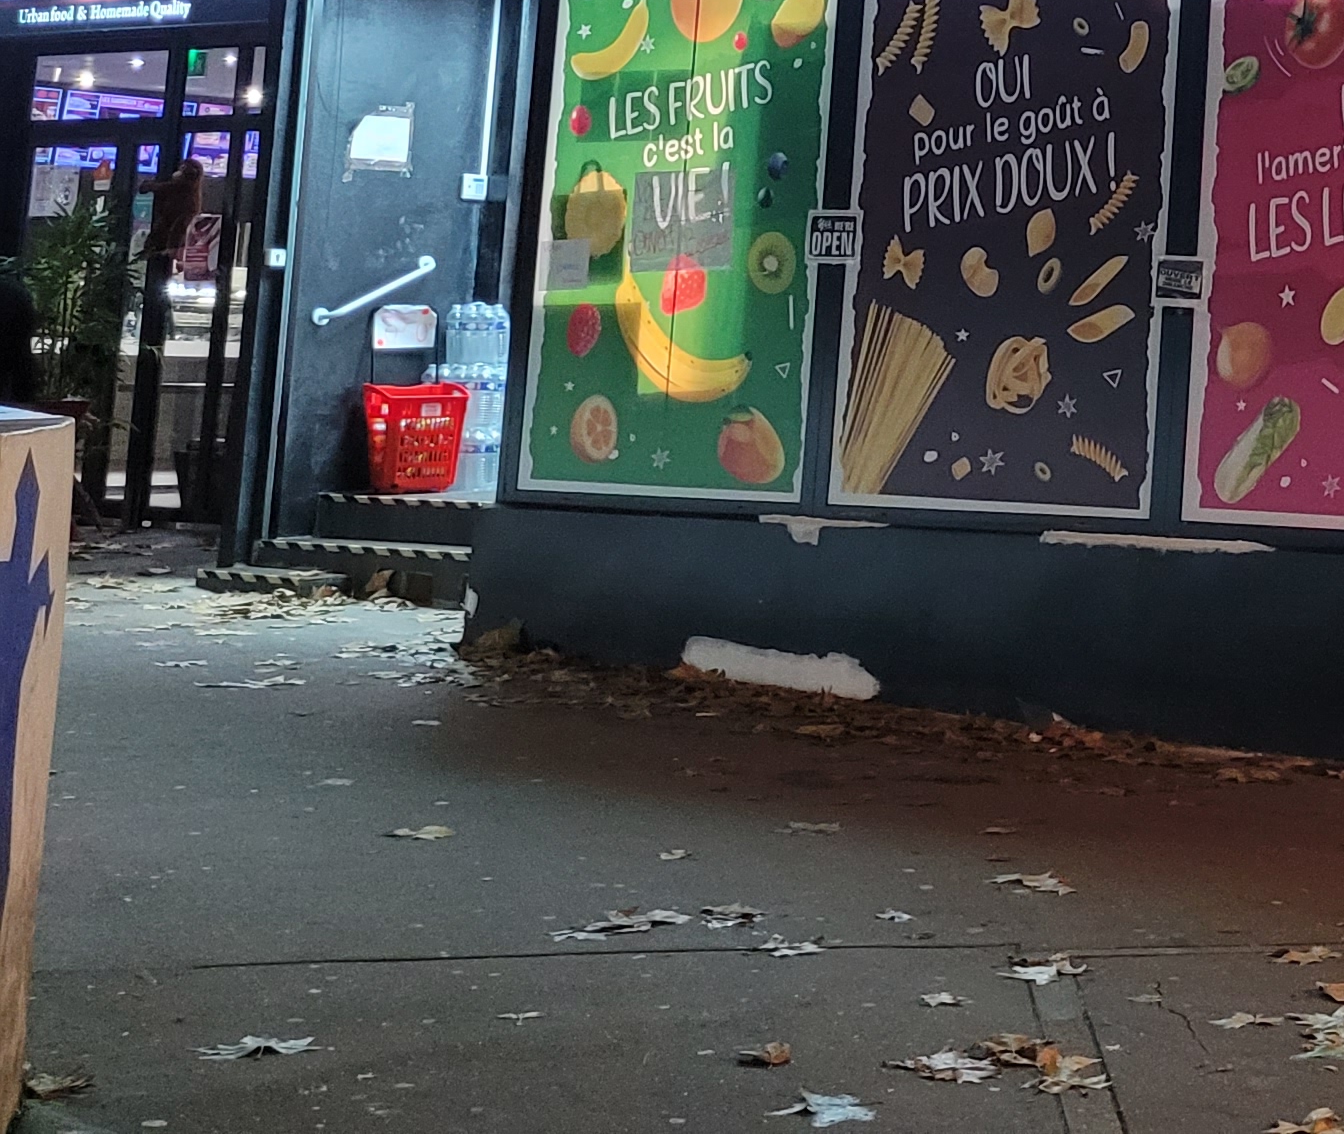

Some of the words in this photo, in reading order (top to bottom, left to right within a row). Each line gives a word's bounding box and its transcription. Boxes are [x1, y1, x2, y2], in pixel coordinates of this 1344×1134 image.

[18, 7, 50, 24] Urban
[50, 4, 74, 22] food
[76, 4, 88, 21] &
[90, 0, 149, 20] Homemade
[609, 86, 661, 140] LES
[668, 60, 773, 126] FRUITS
[975, 54, 1032, 109] OUI
[643, 127, 704, 167] c'est
[713, 121, 734, 152] la
[913, 122, 975, 165] pour
[986, 112, 1009, 144] le
[1019, 95, 1083, 145] goût
[1092, 87, 1111, 122] à
[653, 167, 710, 229] VIE
[903, 160, 985, 233] PRIX
[995, 136, 1098, 214] DOUX
[811, 231, 854, 255] OPEN
[1248, 190, 1312, 263] LES
